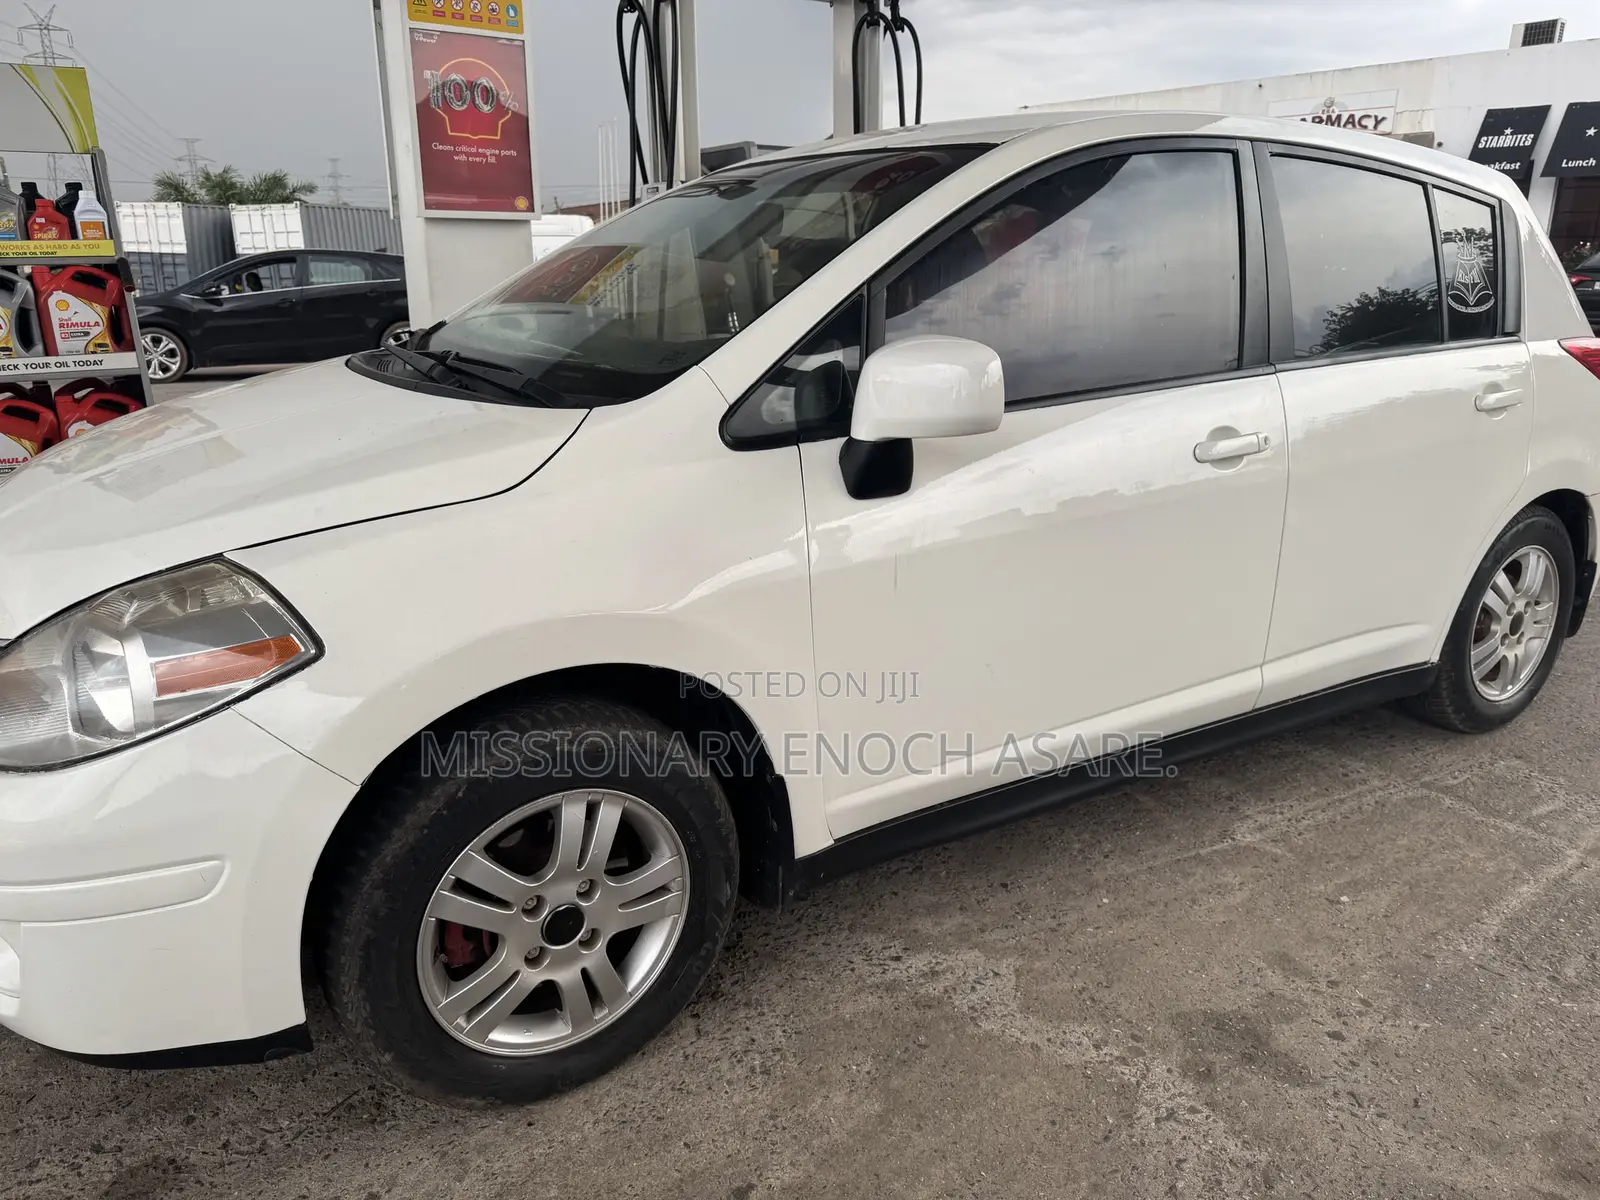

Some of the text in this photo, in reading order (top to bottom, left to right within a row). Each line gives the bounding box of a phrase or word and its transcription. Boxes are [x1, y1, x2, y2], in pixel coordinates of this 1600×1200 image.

[1300, 114, 1387, 130] RMACY
[1478, 133, 1535, 149] STARBITES
[431, 142, 454, 151] Cleans
[455, 145, 477, 153] critical
[500, 149, 517, 157] parts
[453, 154, 468, 162] with
[468, 156, 486, 164] every
[1561, 158, 1597, 167] Lunch
[1484, 161, 1521, 170] akfast
[58, 321, 100, 329] RIMULA
[0, 359, 104, 372] ECK YOUR OIL TODAY
